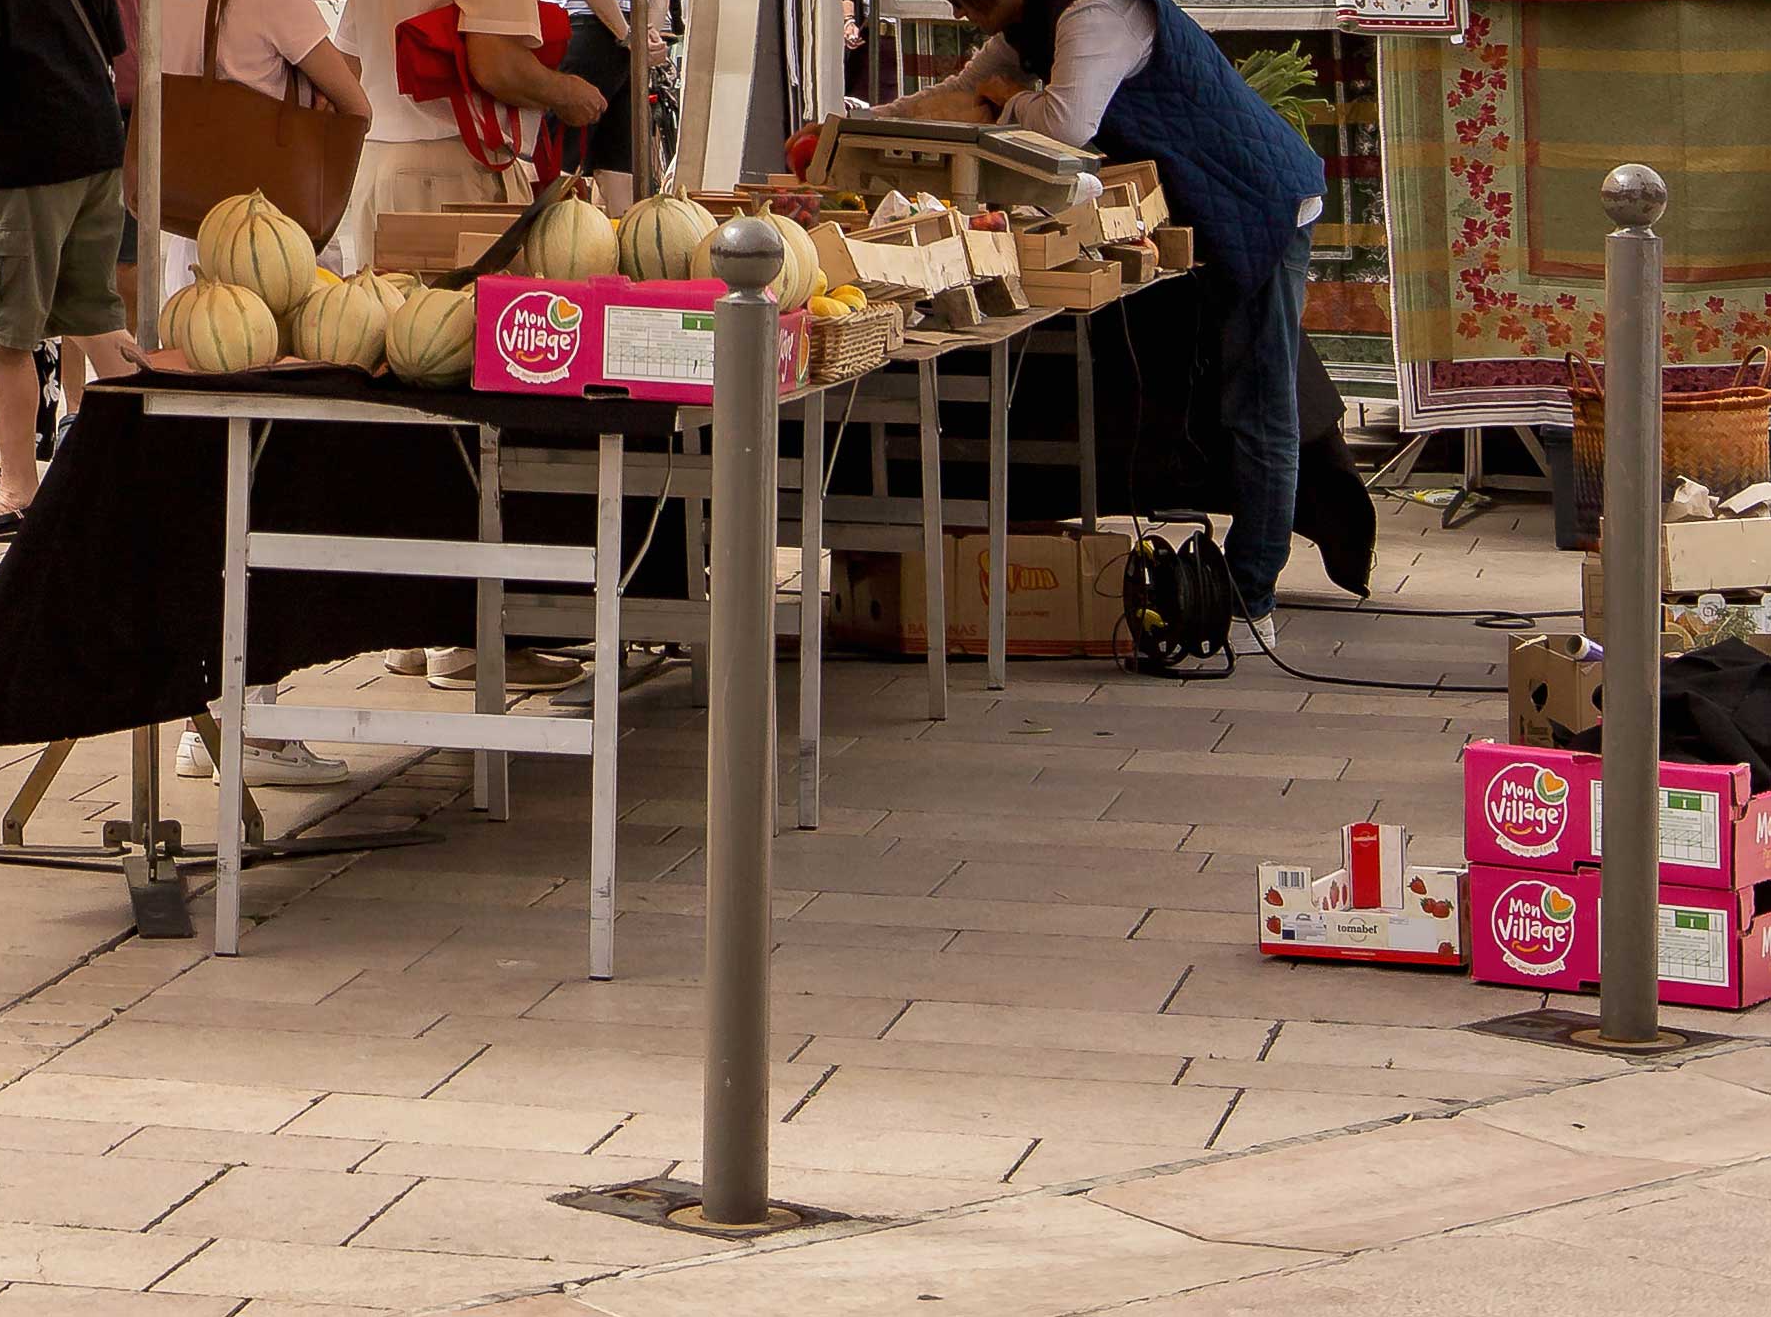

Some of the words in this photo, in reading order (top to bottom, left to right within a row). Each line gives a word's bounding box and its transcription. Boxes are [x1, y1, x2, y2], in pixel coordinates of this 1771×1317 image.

[514, 308, 546, 329] Mon
[502, 326, 571, 360] Village
[1502, 780, 1533, 800] Mon
[1490, 798, 1559, 834] Village
[1509, 897, 1540, 918] Mon
[1337, 923, 1378, 935] tomabel
[1498, 916, 1566, 951] Village
